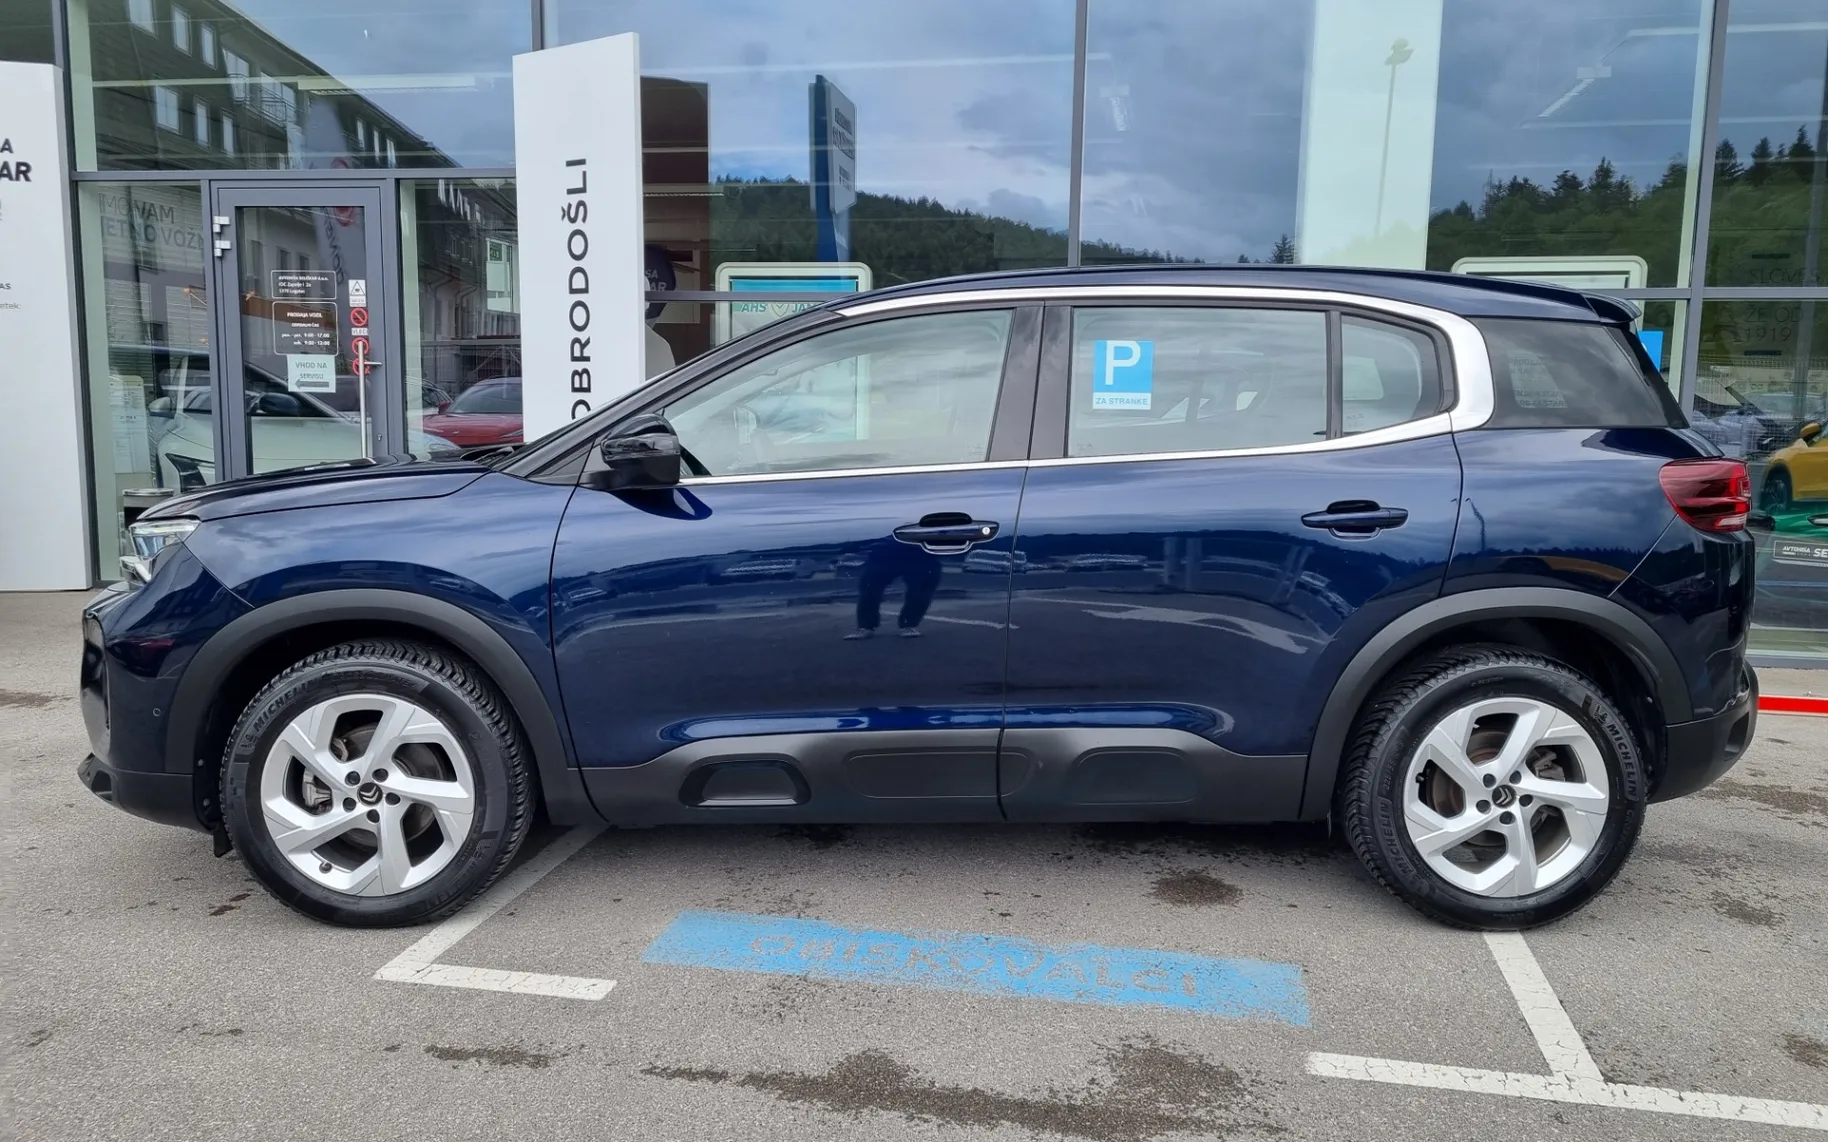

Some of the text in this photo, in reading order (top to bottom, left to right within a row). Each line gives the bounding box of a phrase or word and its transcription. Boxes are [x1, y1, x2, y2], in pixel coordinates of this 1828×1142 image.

[1096, 397, 1149, 406] ZA STRANKE
[1606, 723, 1638, 800] MICHELIN
[751, 934, 1198, 997] OBISKOVALCI
